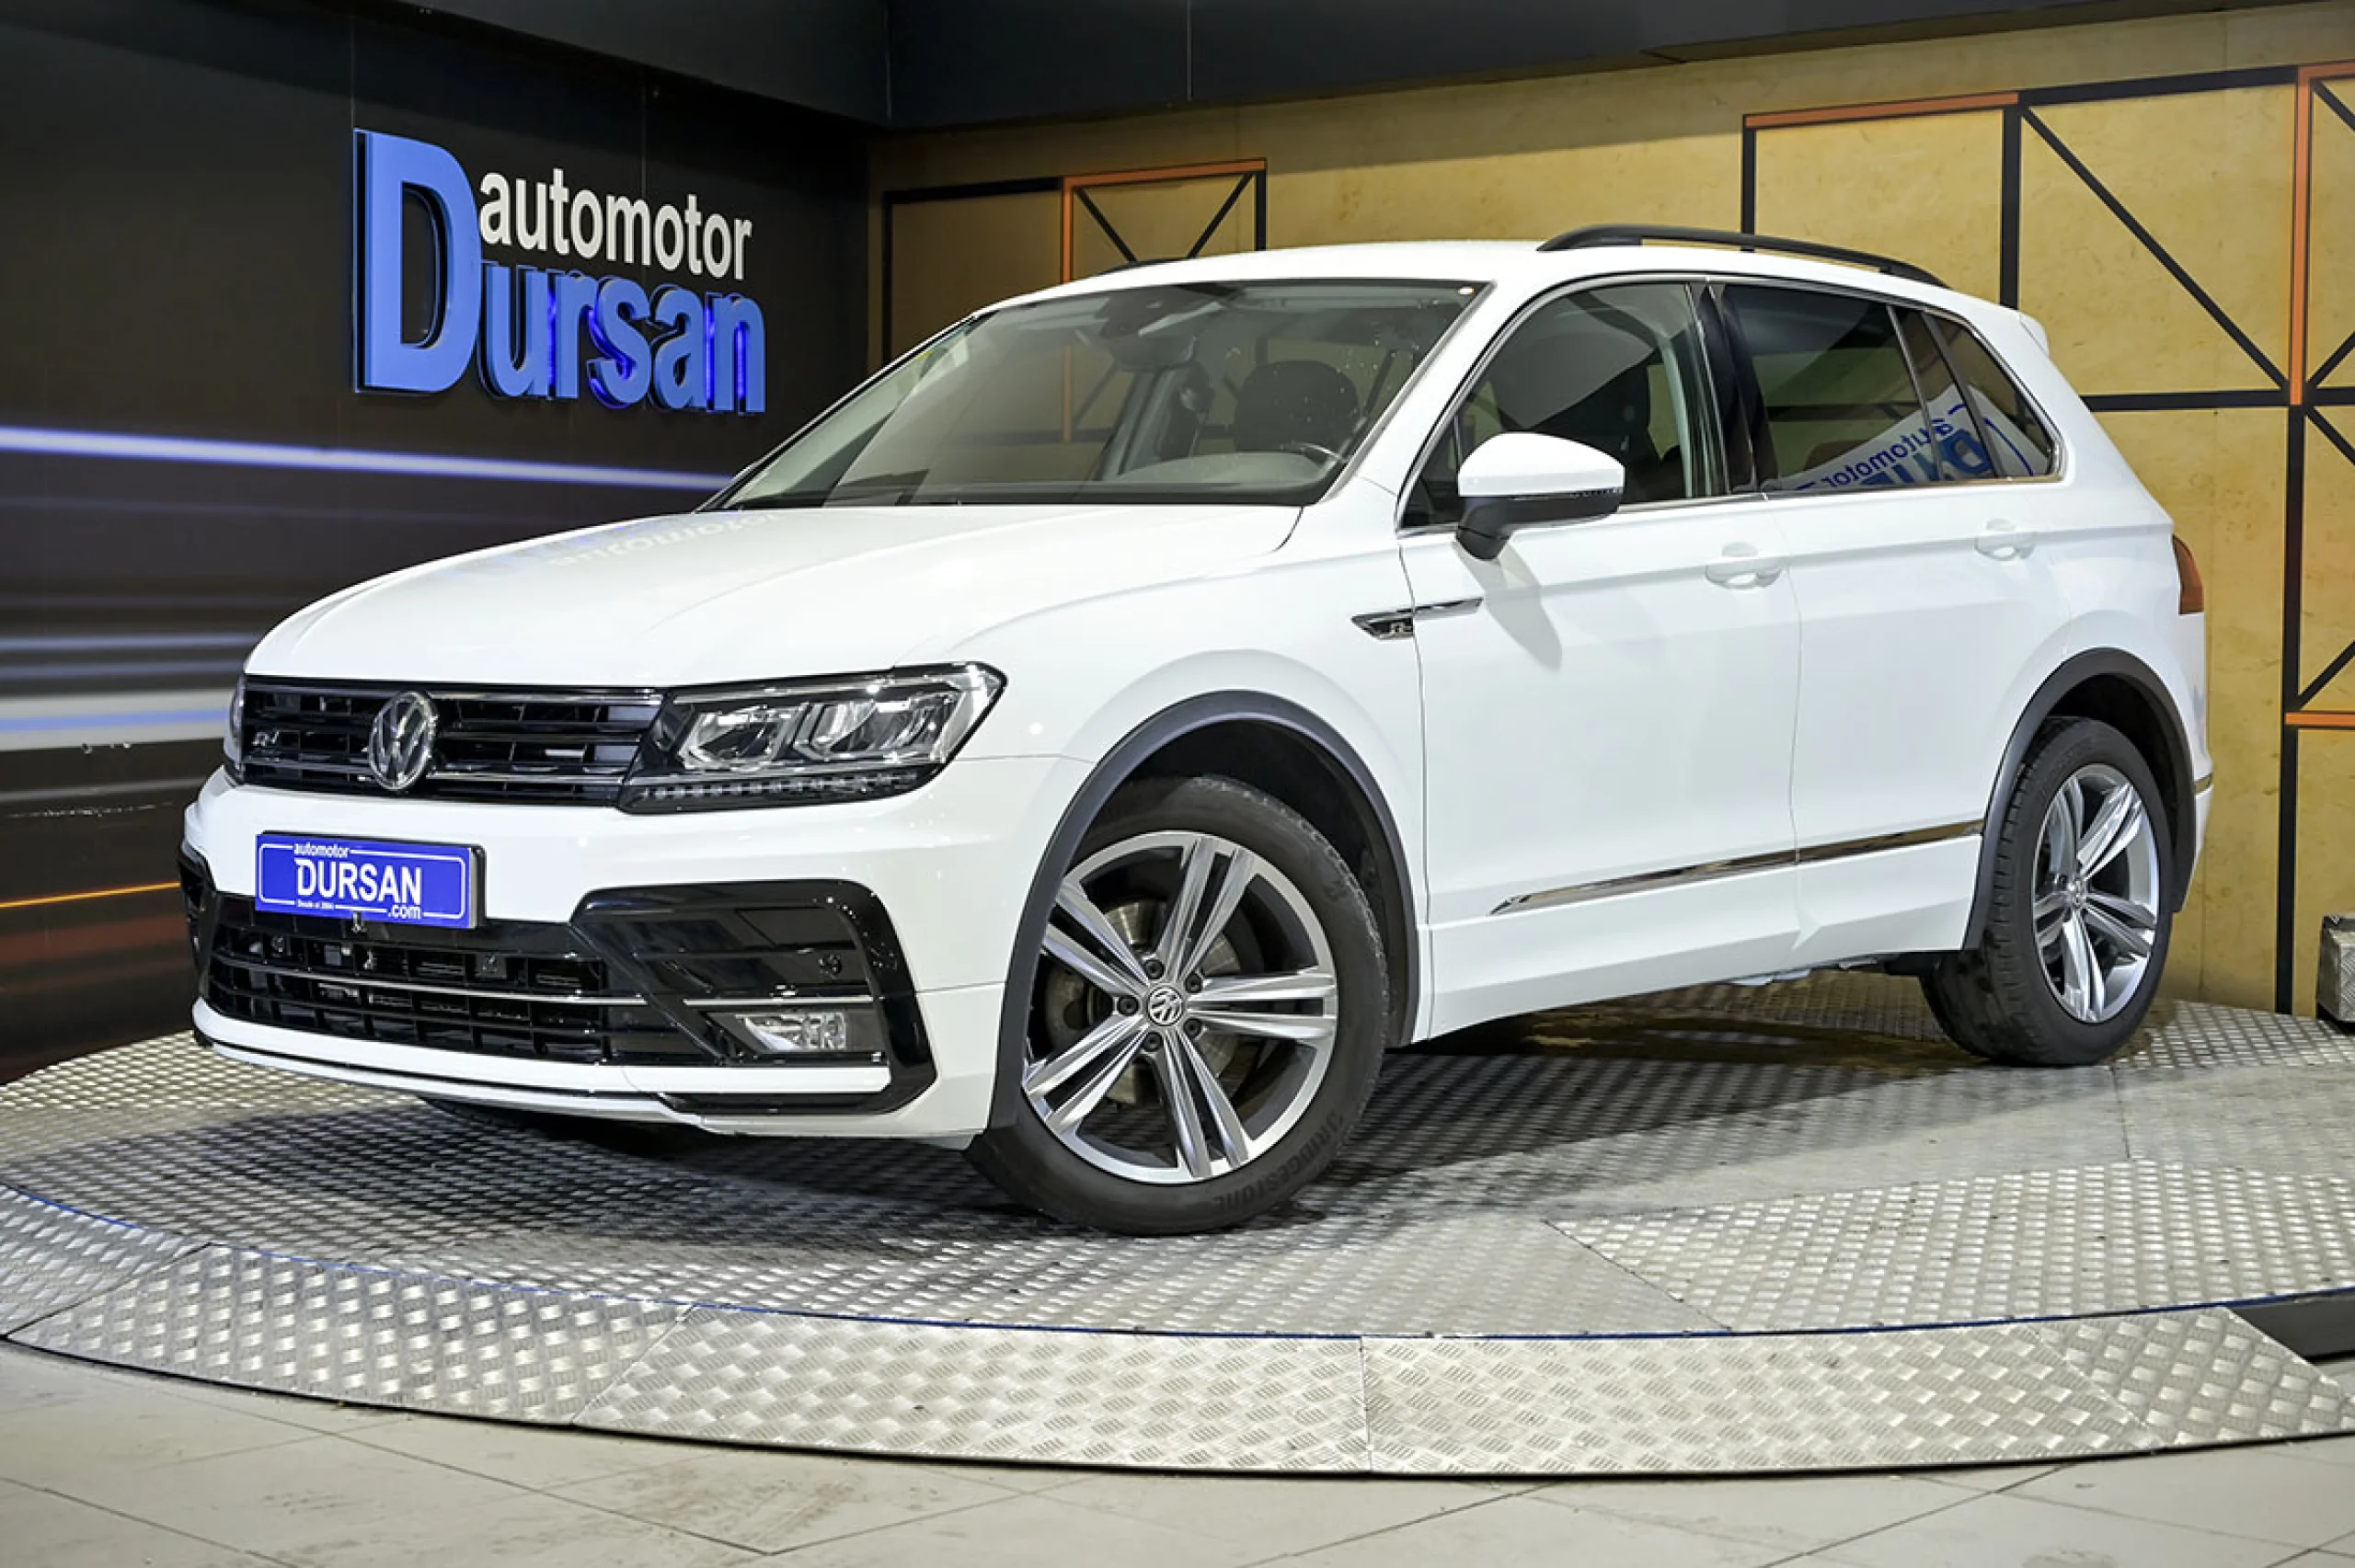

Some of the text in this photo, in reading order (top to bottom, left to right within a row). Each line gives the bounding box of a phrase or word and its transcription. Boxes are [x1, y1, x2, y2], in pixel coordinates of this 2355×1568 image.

[478, 166, 752, 281] automotor
[353, 128, 767, 416] Dursan
[293, 841, 350, 858] automotor
[294, 858, 421, 905] DURSAN
[387, 903, 423, 920] .com
